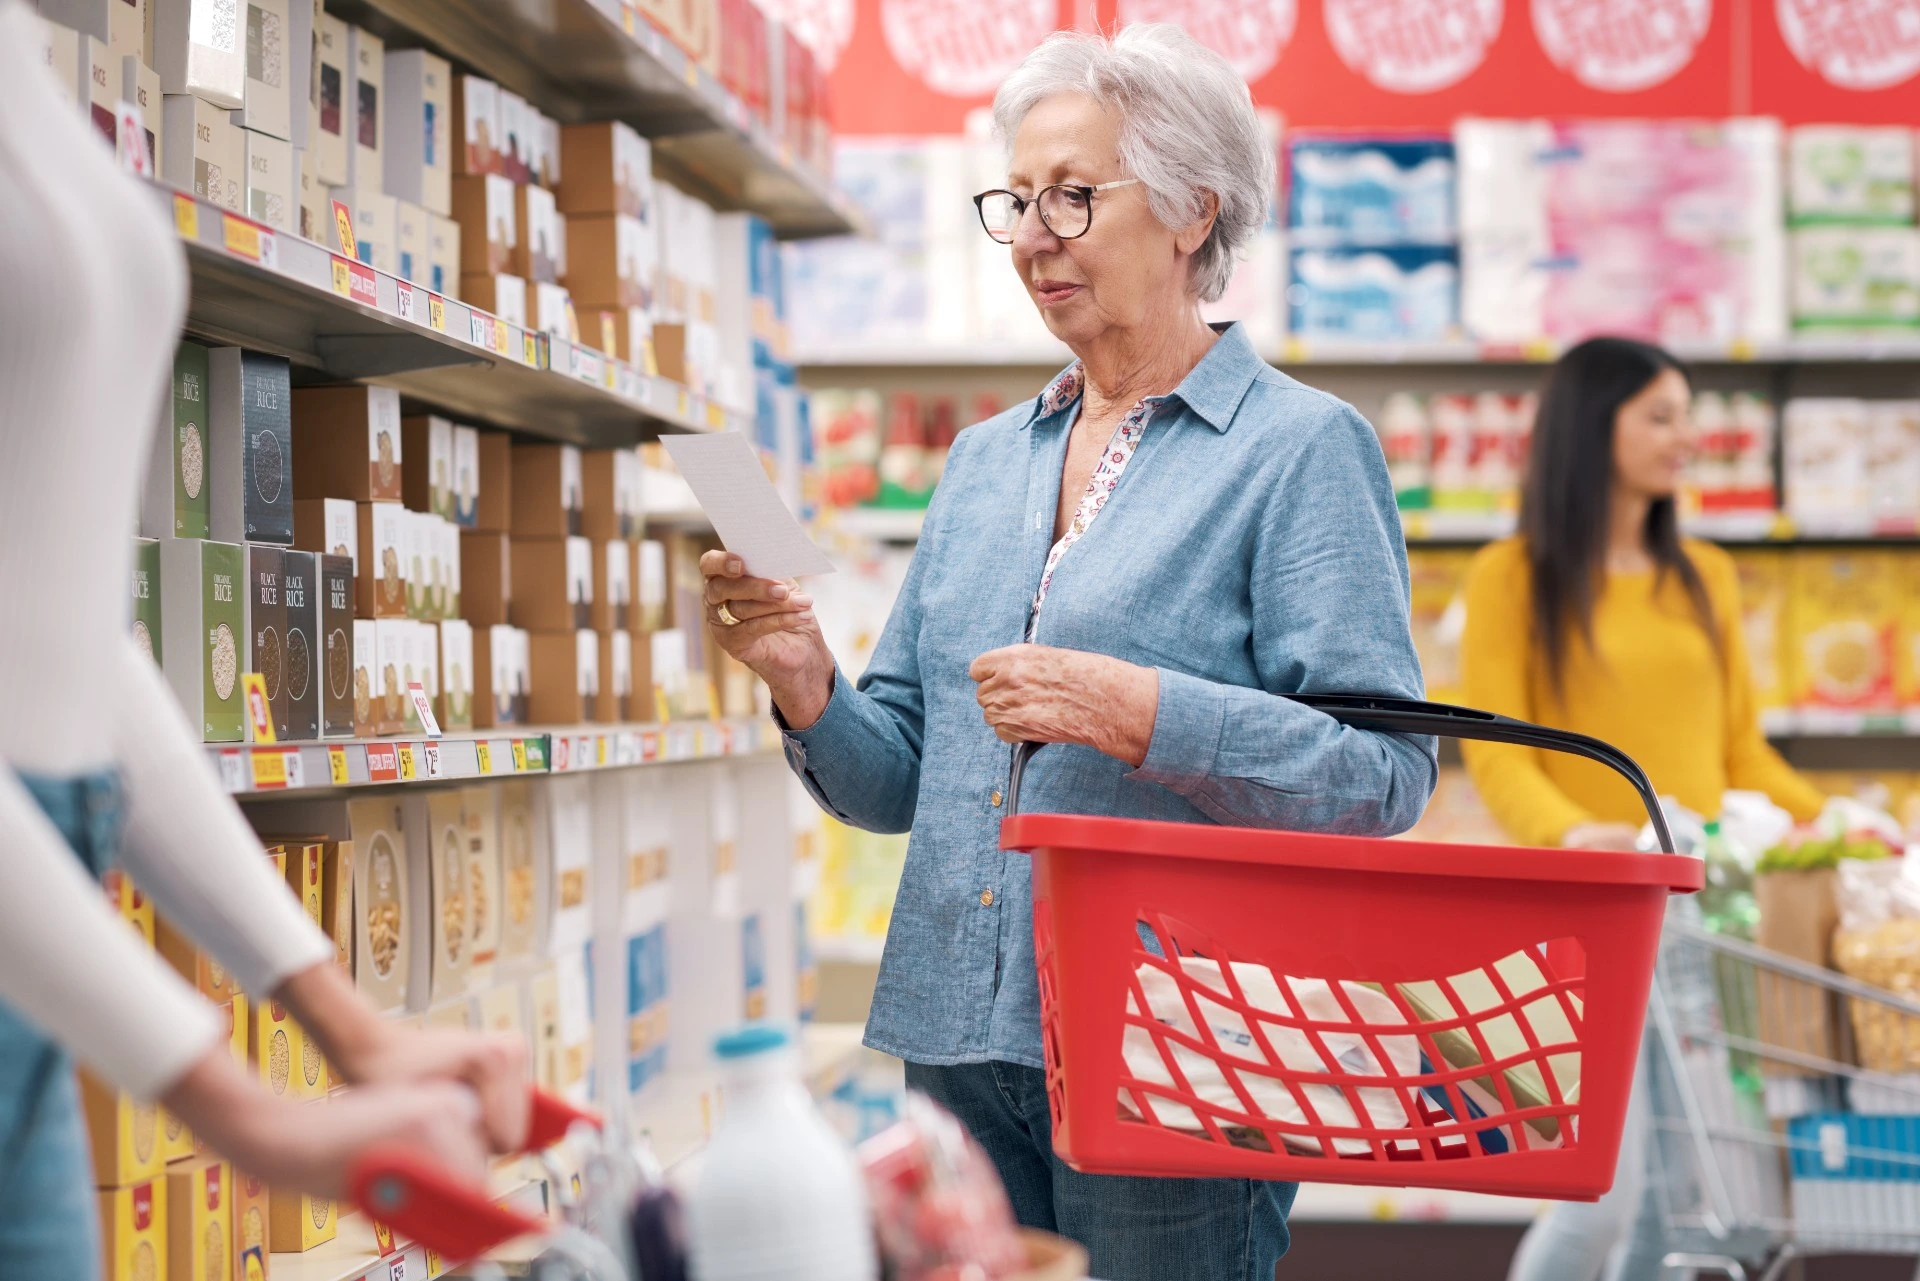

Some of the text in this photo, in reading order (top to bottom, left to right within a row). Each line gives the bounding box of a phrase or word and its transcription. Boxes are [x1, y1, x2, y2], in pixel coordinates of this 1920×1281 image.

[92, 64, 106, 88] RICE
[137, 85, 147, 108] RICE
[197, 122, 210, 144] RICE
[251, 154, 269, 174] RICE
[183, 382, 199, 402] RICE
[256, 376, 277, 390] BLACK
[256, 390, 278, 409] RICE
[260, 572, 277, 586] BLACK
[285, 575, 304, 589] BLACK
[331, 578, 345, 591] BLACK
[214, 583, 233, 602] RICE
[261, 587, 278, 605] RICE
[285, 590, 305, 608] RICE
[331, 591, 346, 610] RICE
